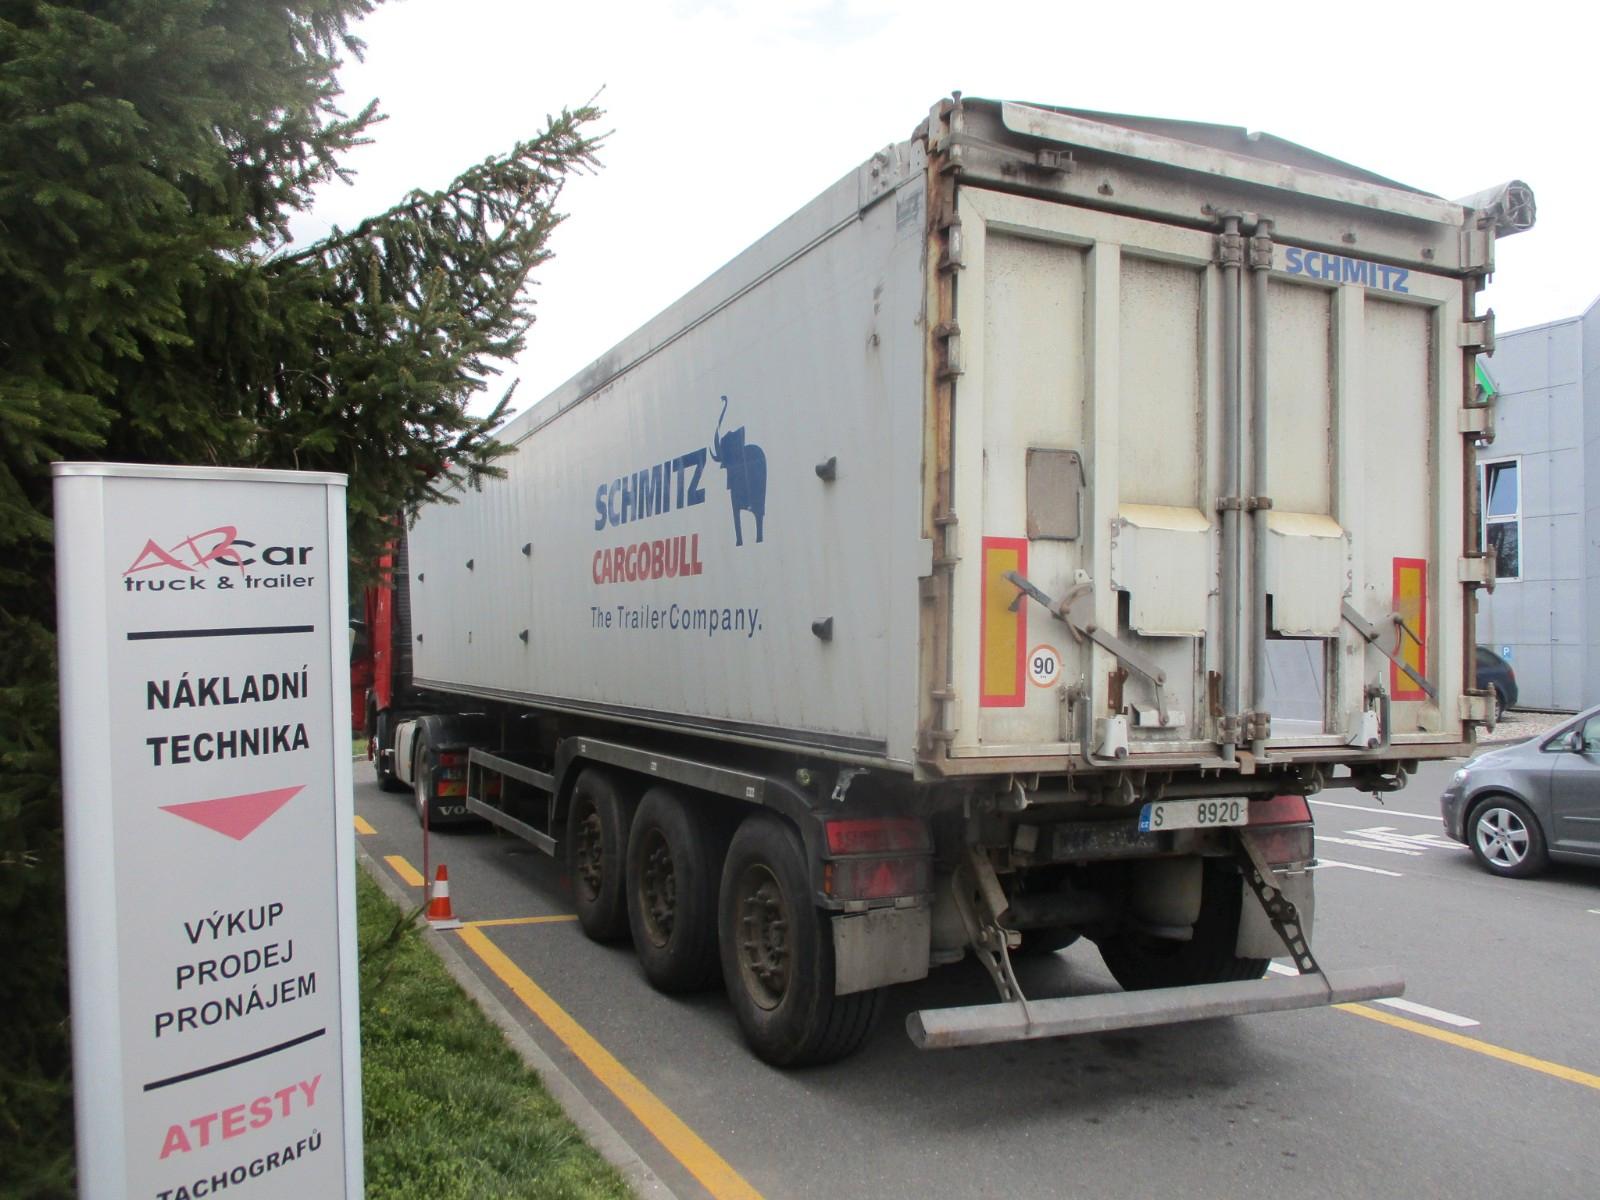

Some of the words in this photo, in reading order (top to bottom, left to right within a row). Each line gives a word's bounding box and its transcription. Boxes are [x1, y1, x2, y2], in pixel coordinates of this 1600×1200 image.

[1286, 247, 1410, 293] SCHMITZ
[595, 448, 707, 531] SCHMITZ
[592, 533, 703, 585] CARGOBULL
[124, 576, 206, 591] truck
[217, 576, 234, 590] &
[245, 574, 315, 589] trailer
[591, 606, 612, 629] The
[147, 664, 309, 710] NÁKLADNÍ
[1034, 657, 1054, 675] 90
[146, 722, 310, 767] TECHNIKA
[1154, 806, 1164, 826] S
[1198, 802, 1239, 823] 8920
[184, 902, 284, 944] VÝKUP
[176, 939, 294, 990] PRODEJ
[155, 972, 317, 1038] PRONÁJEM
[159, 1074, 322, 1160] ATESTY
